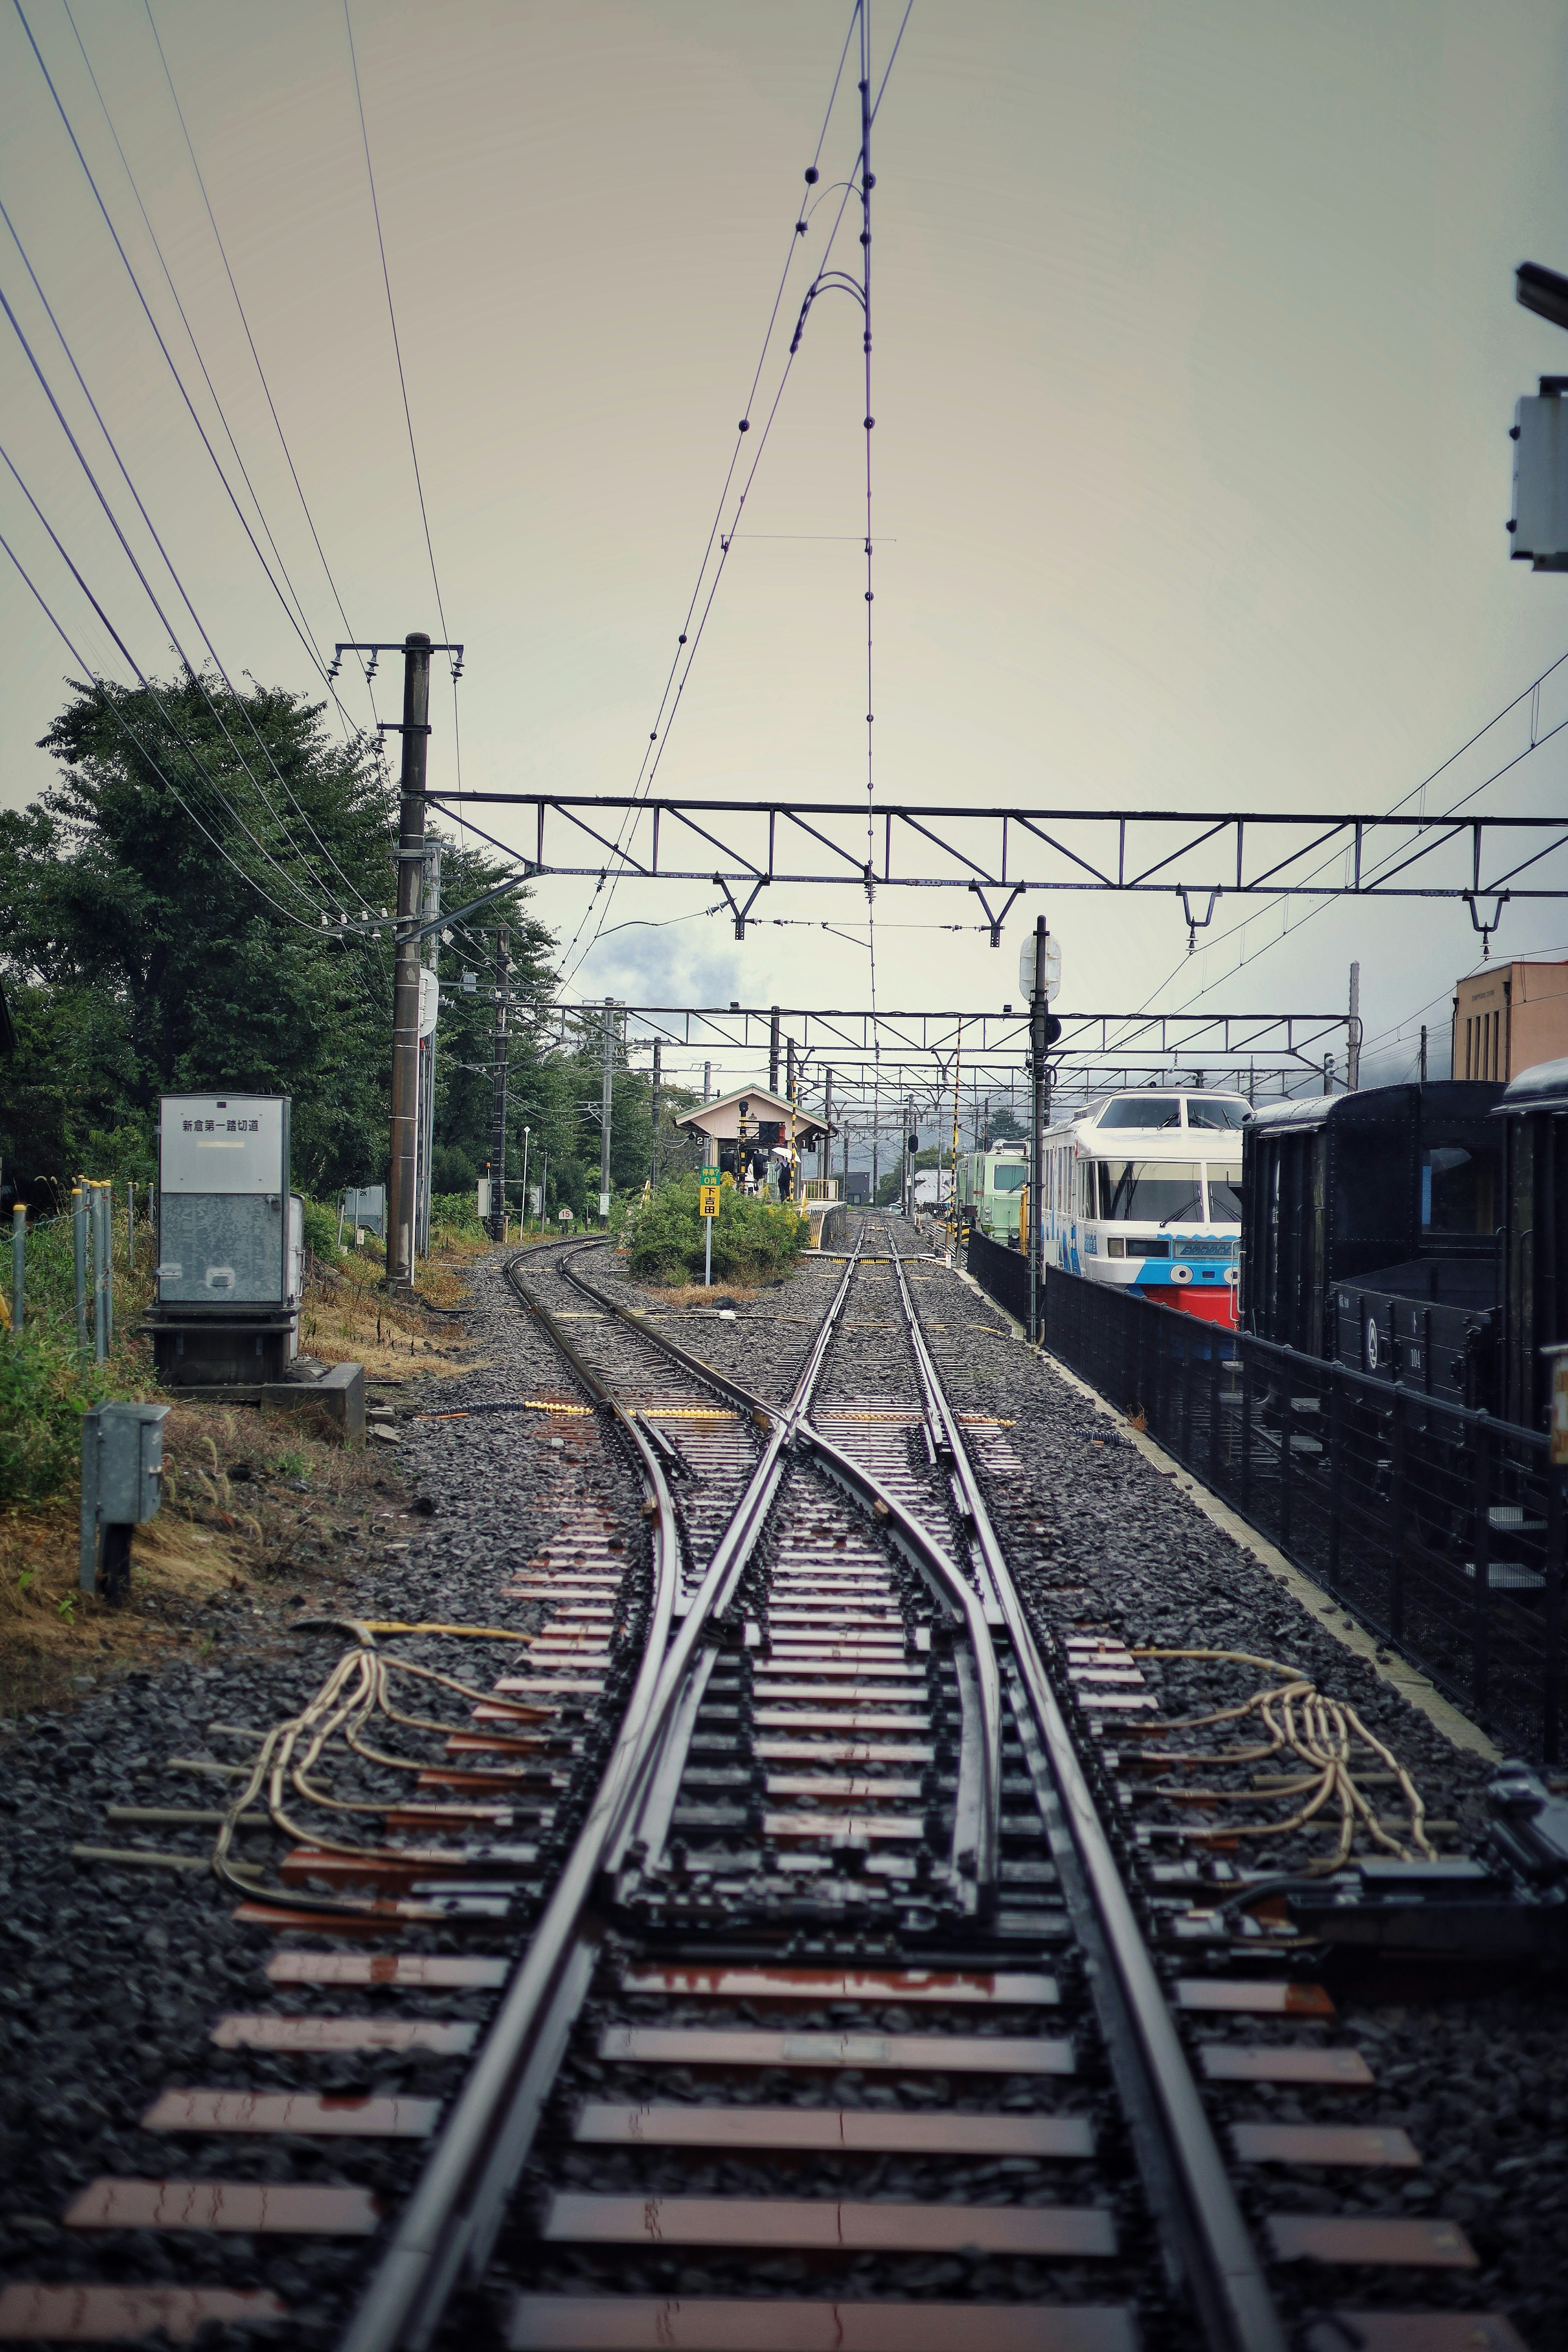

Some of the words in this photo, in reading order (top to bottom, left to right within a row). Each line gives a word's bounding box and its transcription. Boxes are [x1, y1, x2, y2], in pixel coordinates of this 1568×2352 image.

[182, 1119, 259, 1132] 新倉第一踏切道
[704, 1187, 716, 1214] 下吉田
[1410, 1349, 1421, 1369] 104
